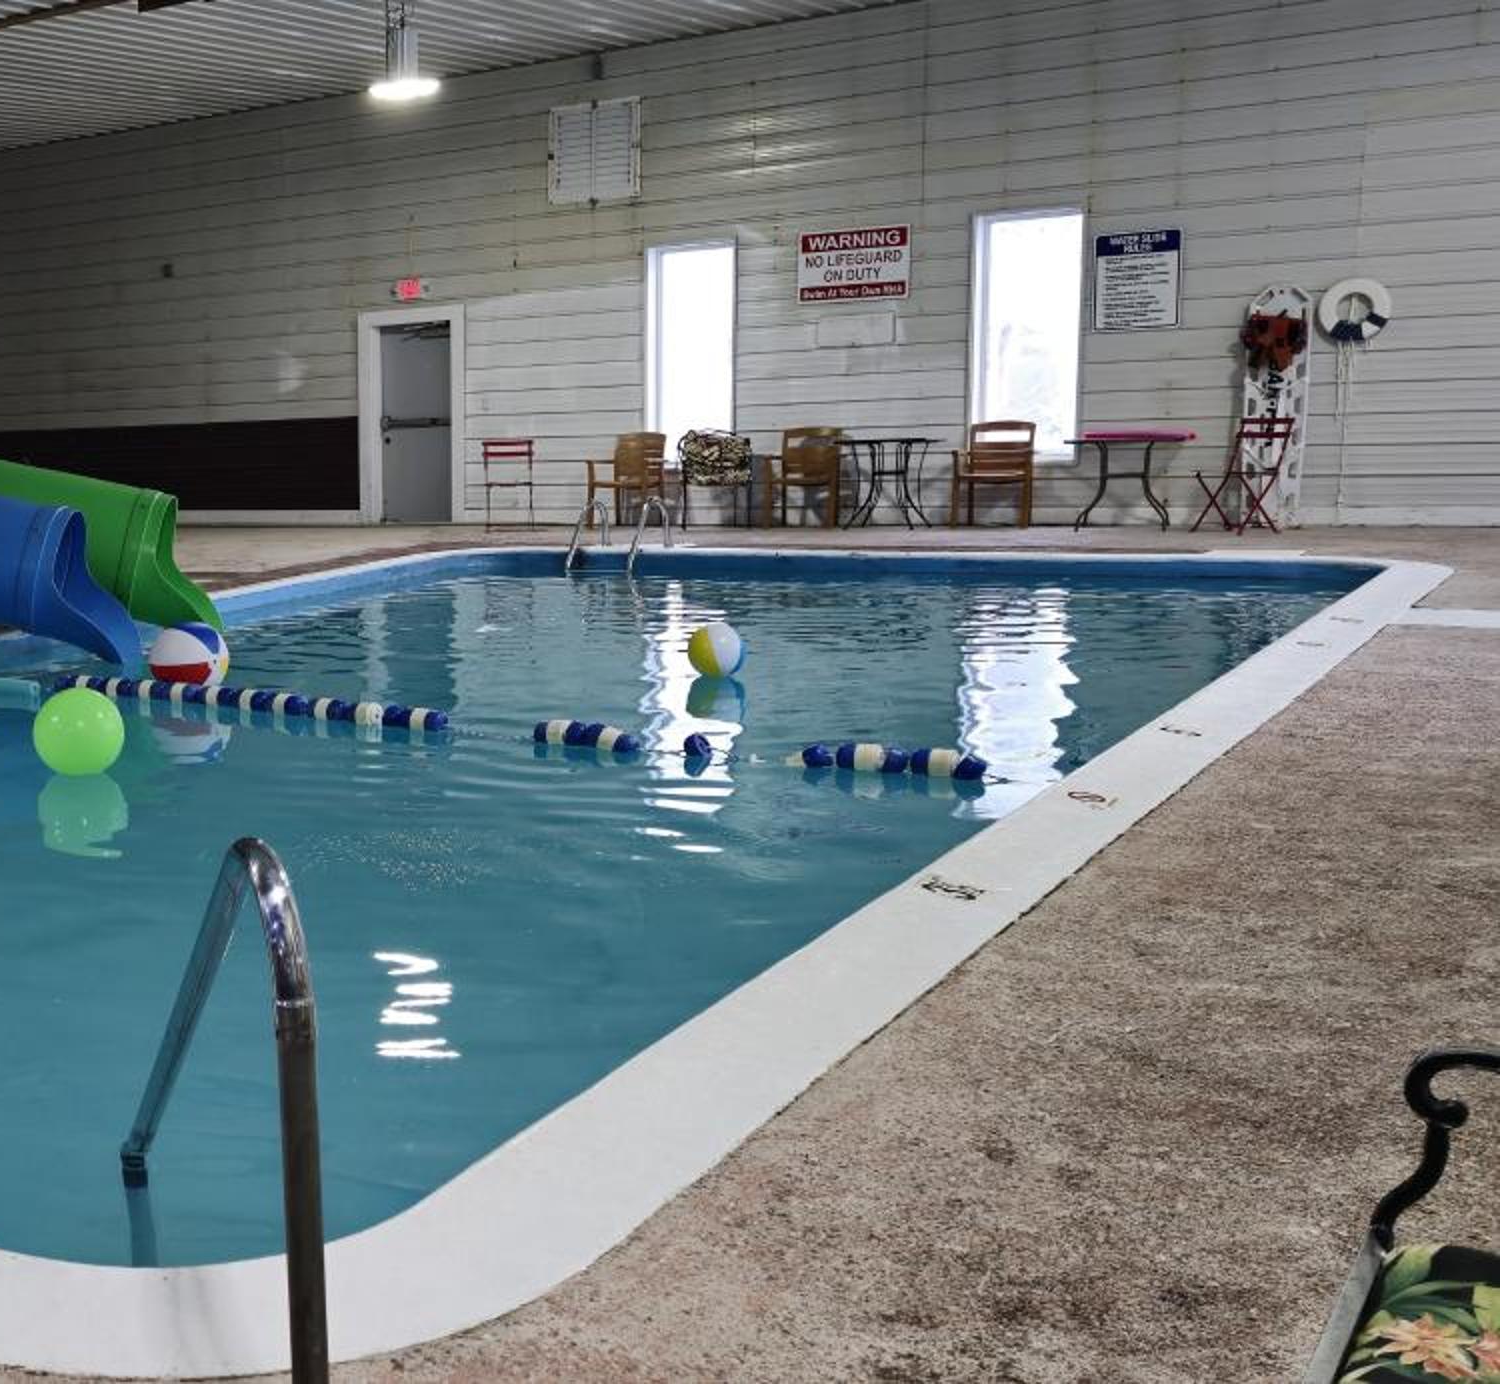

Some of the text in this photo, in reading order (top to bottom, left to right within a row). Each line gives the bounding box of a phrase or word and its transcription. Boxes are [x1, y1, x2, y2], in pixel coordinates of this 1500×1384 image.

[808, 230, 901, 251] WARNING
[806, 249, 903, 269] NO LIFEGUARD
[823, 266, 881, 283] ON DUTY
[861, 285, 882, 296] Own
